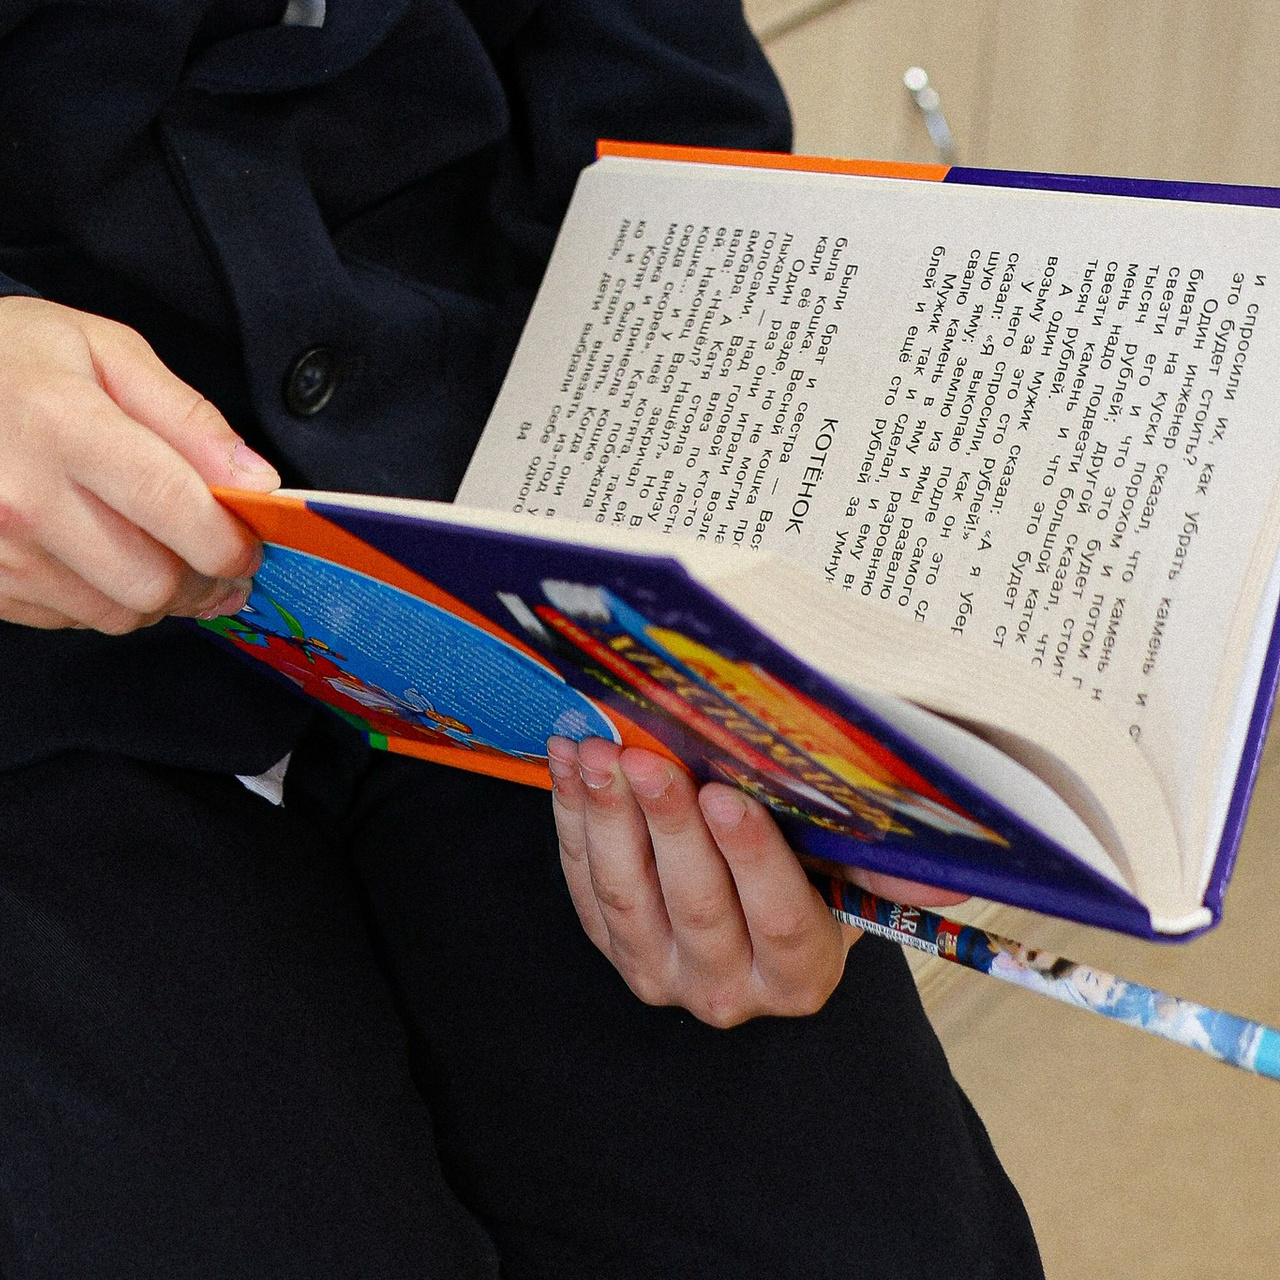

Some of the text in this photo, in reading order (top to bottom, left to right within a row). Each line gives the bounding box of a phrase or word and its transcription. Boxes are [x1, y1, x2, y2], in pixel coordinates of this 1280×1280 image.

[659, 352, 686, 394] Вася
[662, 230, 778, 535] голосами. Вася влез по лестн
[677, 266, 717, 340] Наконец
[682, 232, 795, 528] лыхали над головой кто-то
[699, 340, 725, 381] Катя
[724, 235, 829, 511] кали её везде, но не могли
[745, 236, 849, 505] была кошка. Весной кошка
[746, 364, 767, 398] они
[763, 319, 783, 351] раз
[778, 263, 859, 464] Были брат сестра
[779, 258, 806, 306] Один
[844, 245, 947, 518] блей ещё сто рублей за
[849, 273, 958, 561] Мужик так сделал, ему
[962, 255, 1059, 541] возьму за это сто рублей!»
[1047, 258, 1099, 399] тысяч рублей.
[1182, 271, 1246, 467] это будет стоить?
[624, 406, 663, 488] закричал
[638, 474, 658, 499] Но
[646, 469, 675, 523] внизу
[672, 394, 702, 455] стояла
[718, 412, 750, 476] играли
[784, 417, 840, 535] КОТЁНОК
[860, 248, 982, 597] свалю камень яму разровняю
[879, 250, 1001, 600] шую яму; землю из ямы развалю
[897, 252, 1020, 608] сказал: «Я выкопаю подле самого
[924, 305, 1025, 586] него спросили, как он это
[976, 310, 1064, 552] один мужик сказал: «А
[1003, 260, 1119, 610] свезти камень что это будет
[1014, 262, 1140, 645] мень надо подвезти большой каток
[1043, 264, 1161, 612] тысяч рублей; другой сказал,
[1072, 266, 1181, 600] свезти его что это будет
[1077, 268, 1205, 660] бивать на куски порохом потом
[1096, 298, 1219, 674] Один инженер сказал, что камень
[1141, 302, 1260, 676] спросили их, как убрать камень
